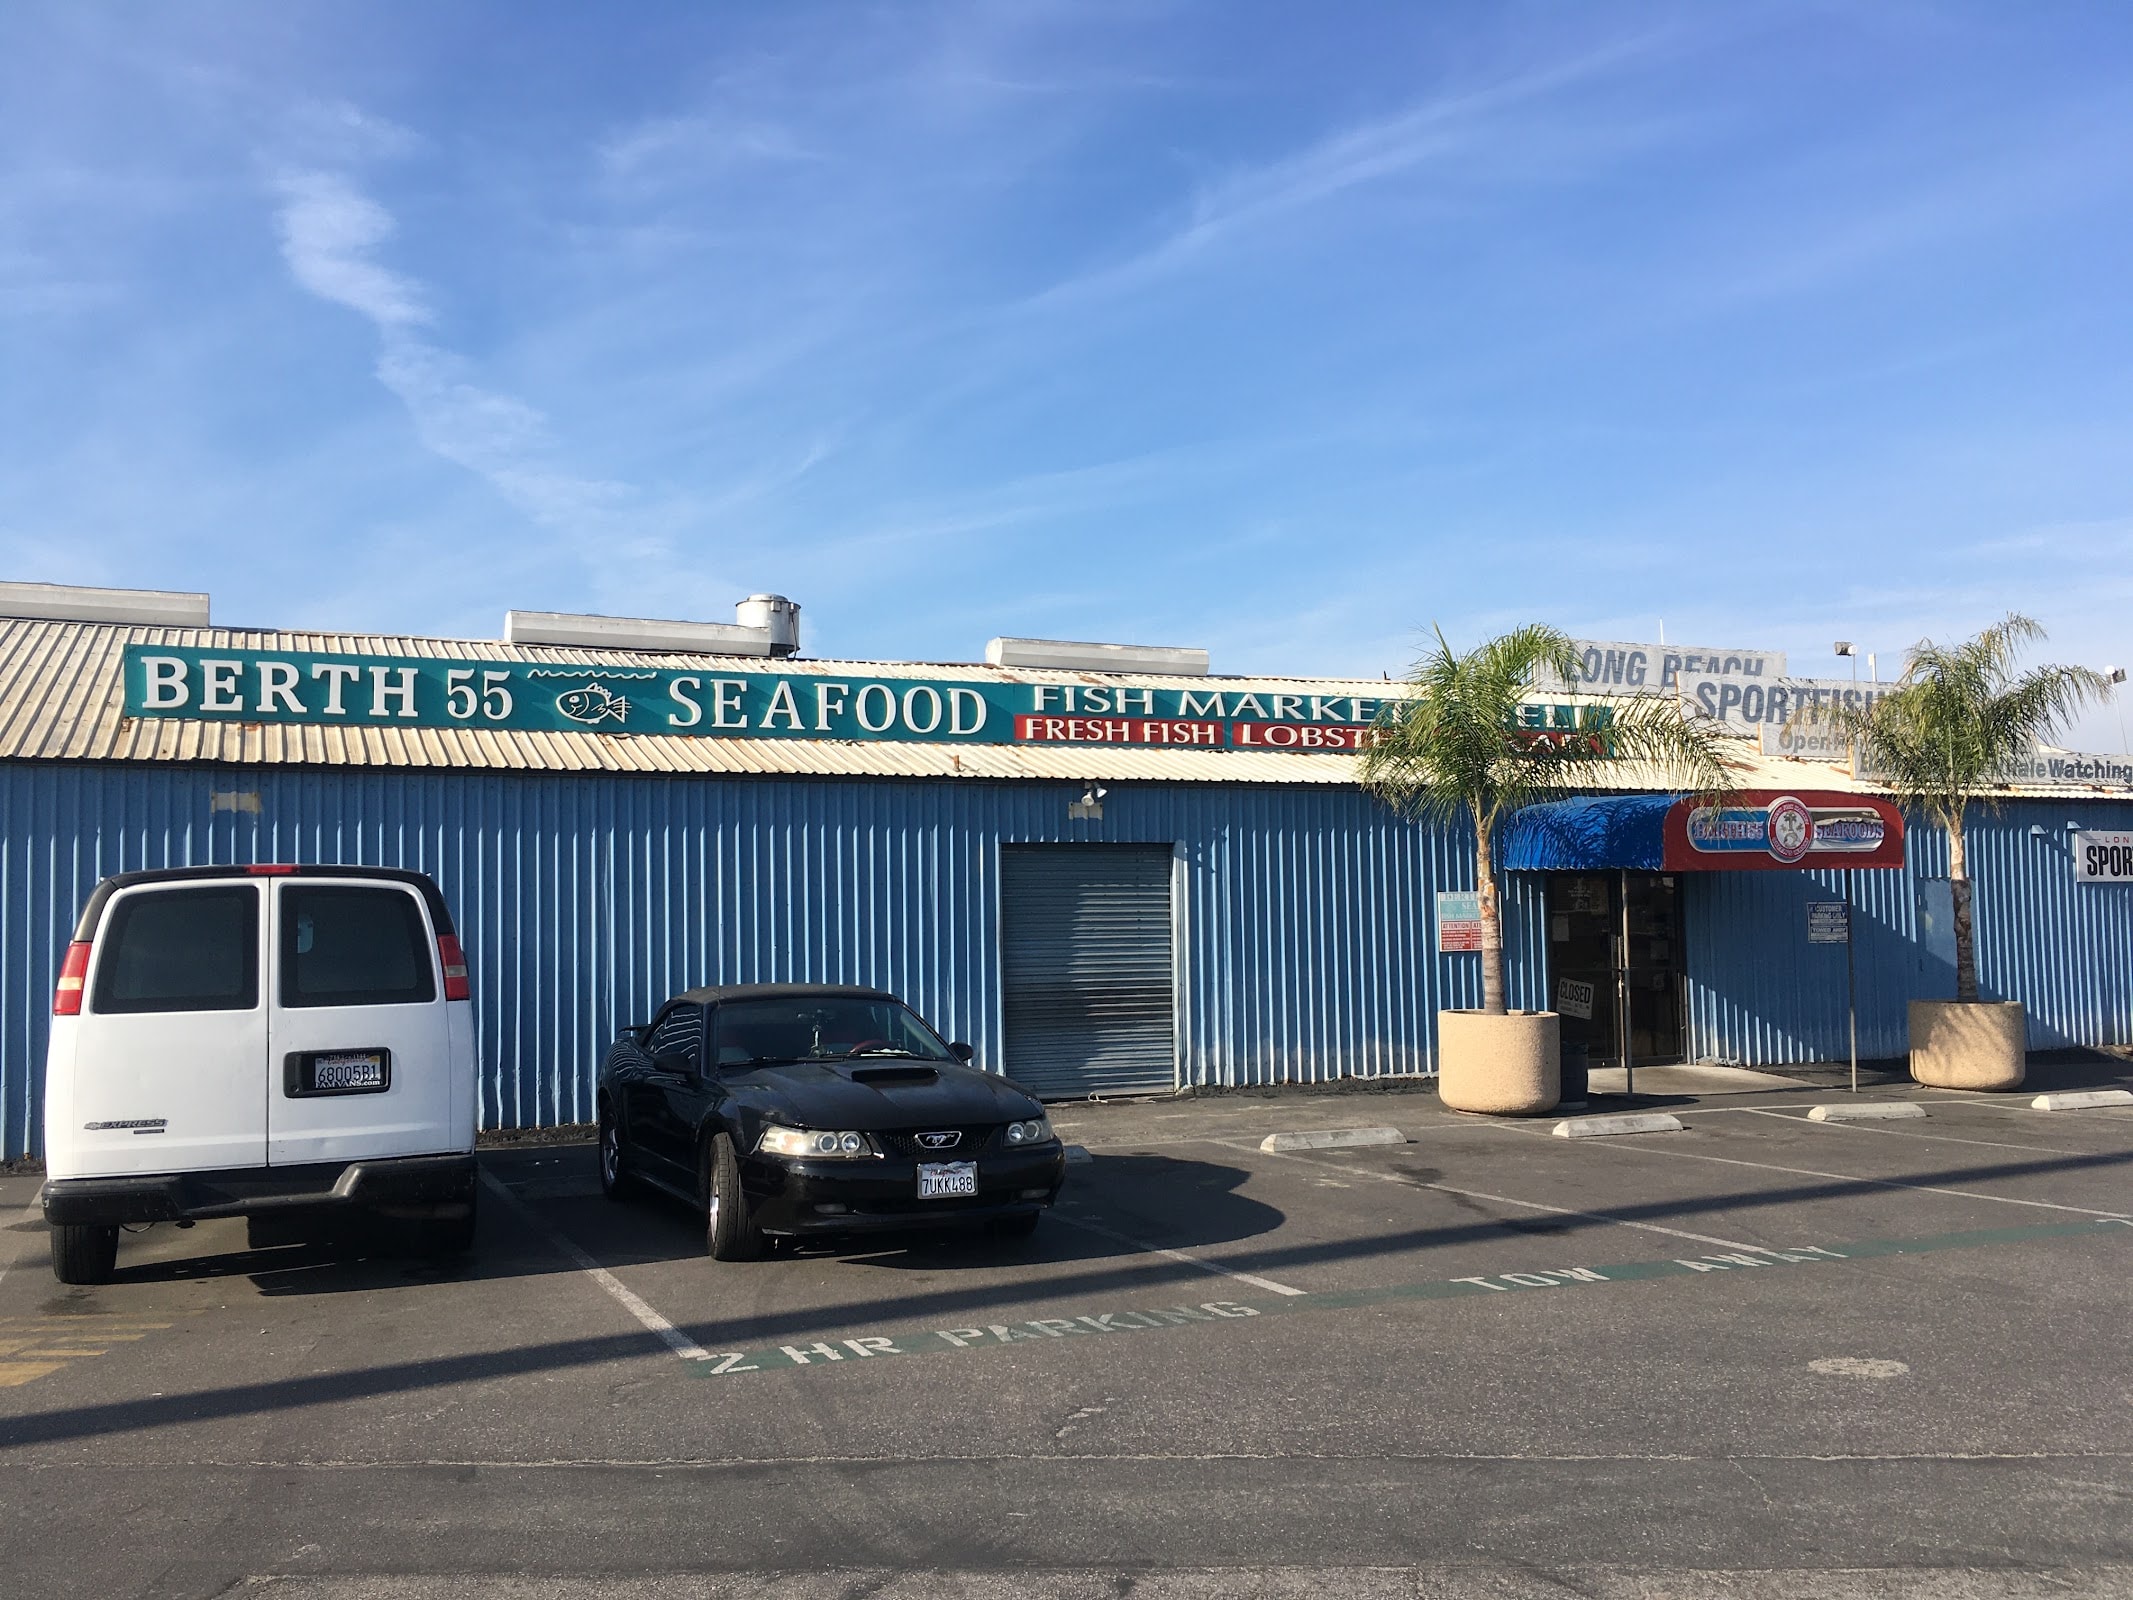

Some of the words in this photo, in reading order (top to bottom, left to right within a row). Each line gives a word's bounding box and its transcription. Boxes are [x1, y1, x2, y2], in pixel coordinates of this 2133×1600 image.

[141, 656, 419, 718] BERTH
[446, 669, 513, 721] 55
[668, 676, 987, 735] SEAFOOD
[1033, 686, 1153, 715] FISH
[1178, 690, 1412, 723] MARKET
[1514, 704, 1585, 729] ELI
[1025, 718, 1129, 743] FRESH
[1143, 722, 1215, 746] FISH
[2048, 758, 2133, 784] Watching
[1559, 981, 1591, 1004] CLOSED
[318, 1065, 377, 1082] 68005B1
[99, 1118, 167, 1130] EXPRESS
[921, 1176, 973, 1194] 7UKK488
[1449, 1267, 1610, 1291] TOW
[699, 1352, 759, 1375] 2
[779, 1337, 902, 1365] HR
[936, 1301, 1261, 1348] PARKING
